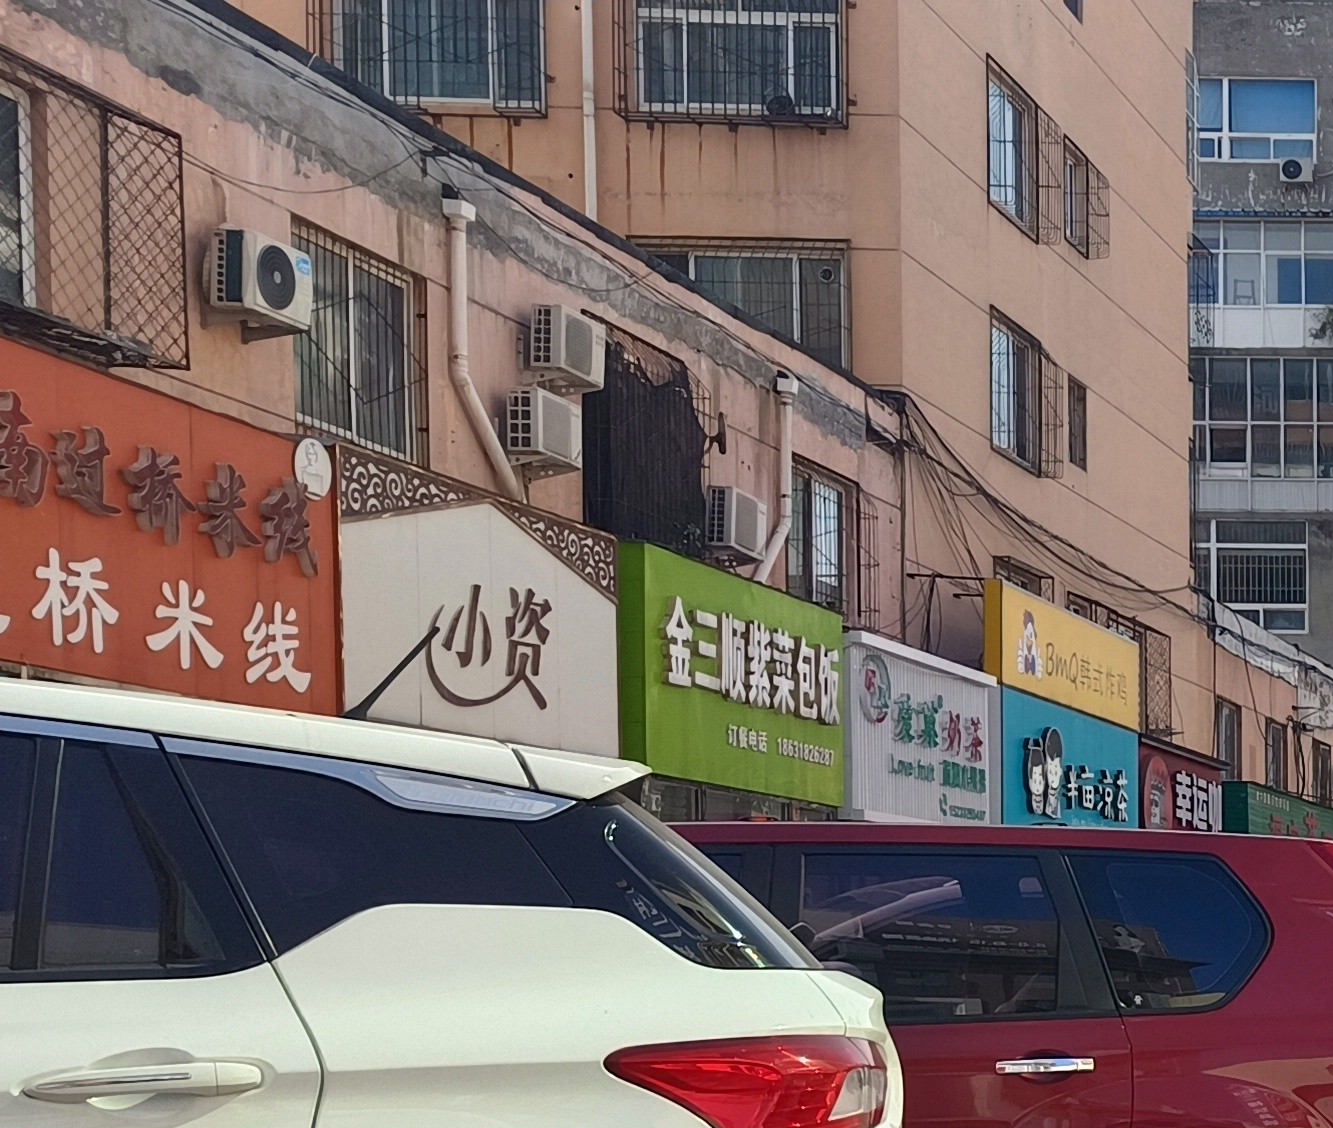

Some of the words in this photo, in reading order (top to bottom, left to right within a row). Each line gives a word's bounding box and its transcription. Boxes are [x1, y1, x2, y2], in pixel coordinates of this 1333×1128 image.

[0, 547, 311, 693] 桥米线
[663, 595, 841, 726] 金三顺紫菜包饭
